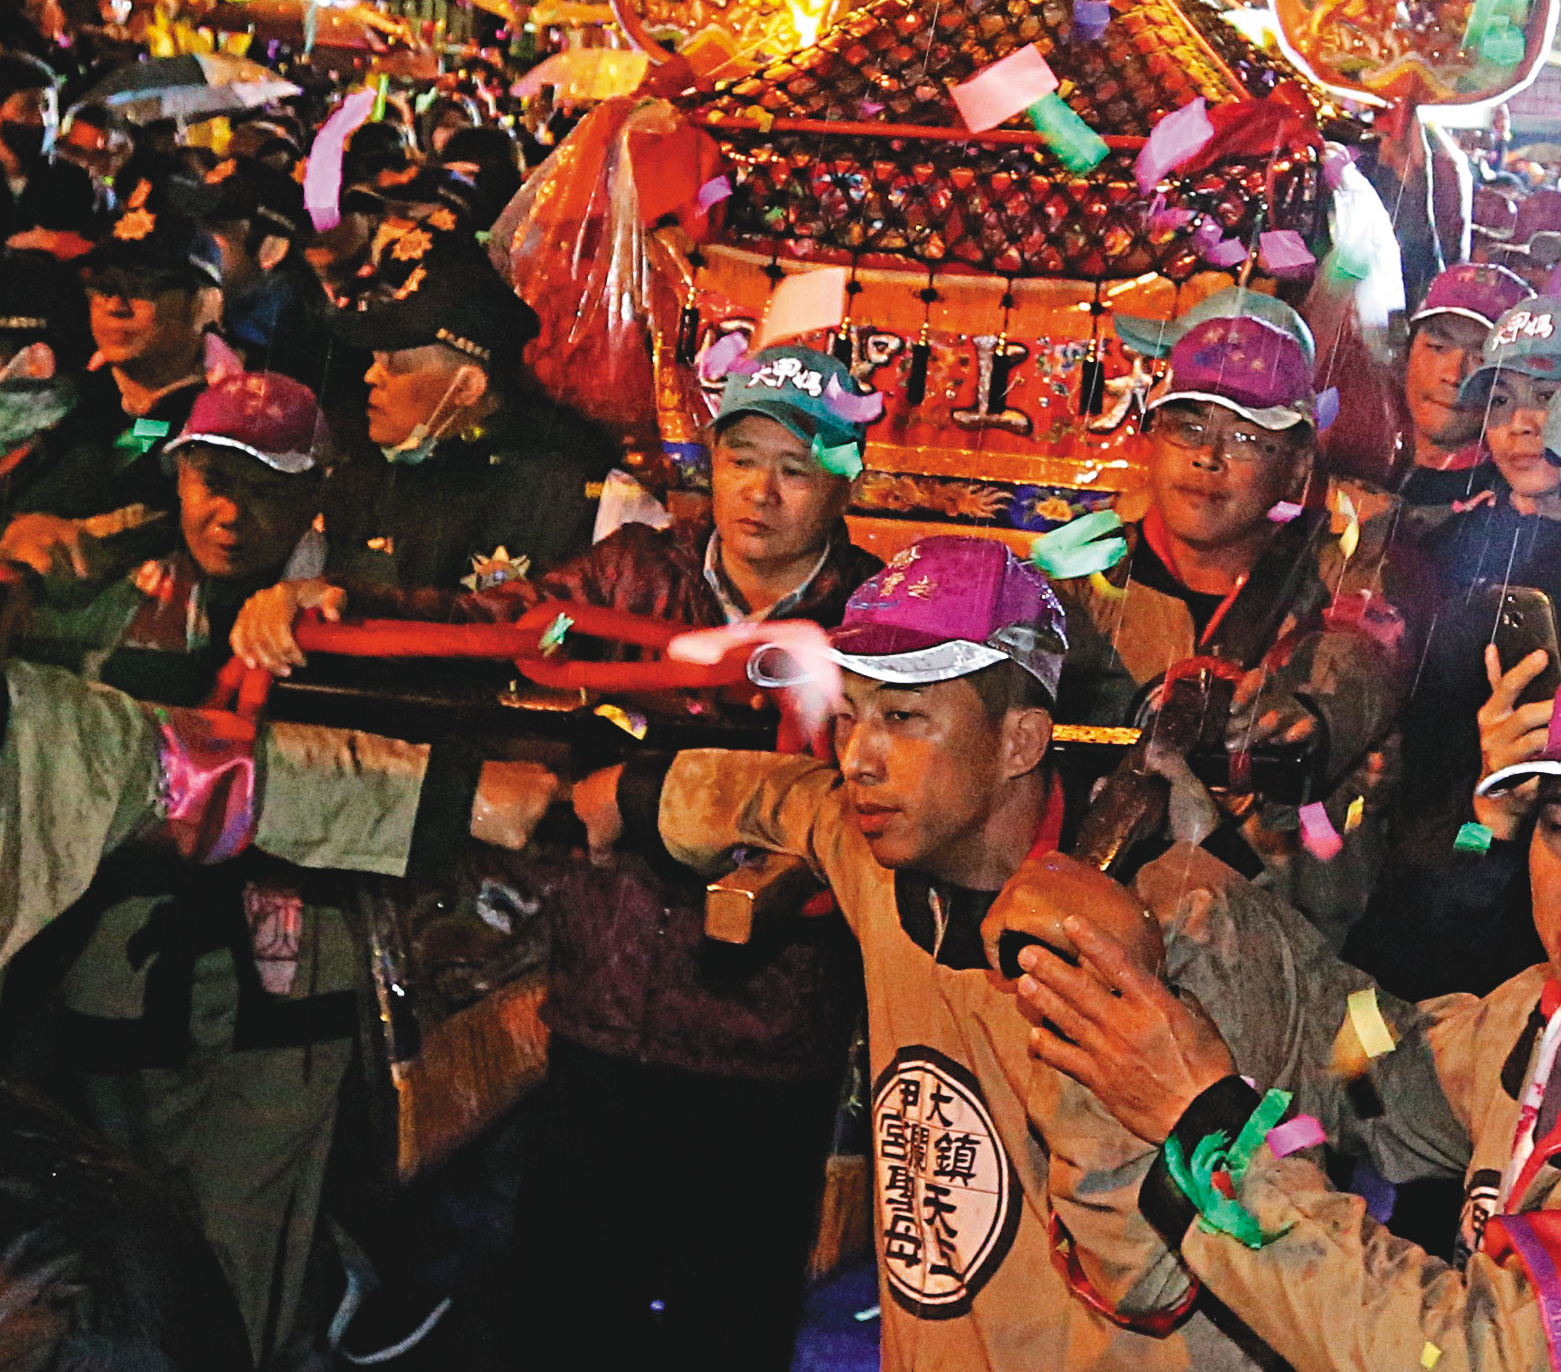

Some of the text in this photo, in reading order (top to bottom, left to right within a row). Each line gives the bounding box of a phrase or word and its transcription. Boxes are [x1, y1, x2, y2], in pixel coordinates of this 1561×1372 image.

[1490, 311, 1556, 352] 大甲媽
[744, 356, 824, 398] 大甲媽
